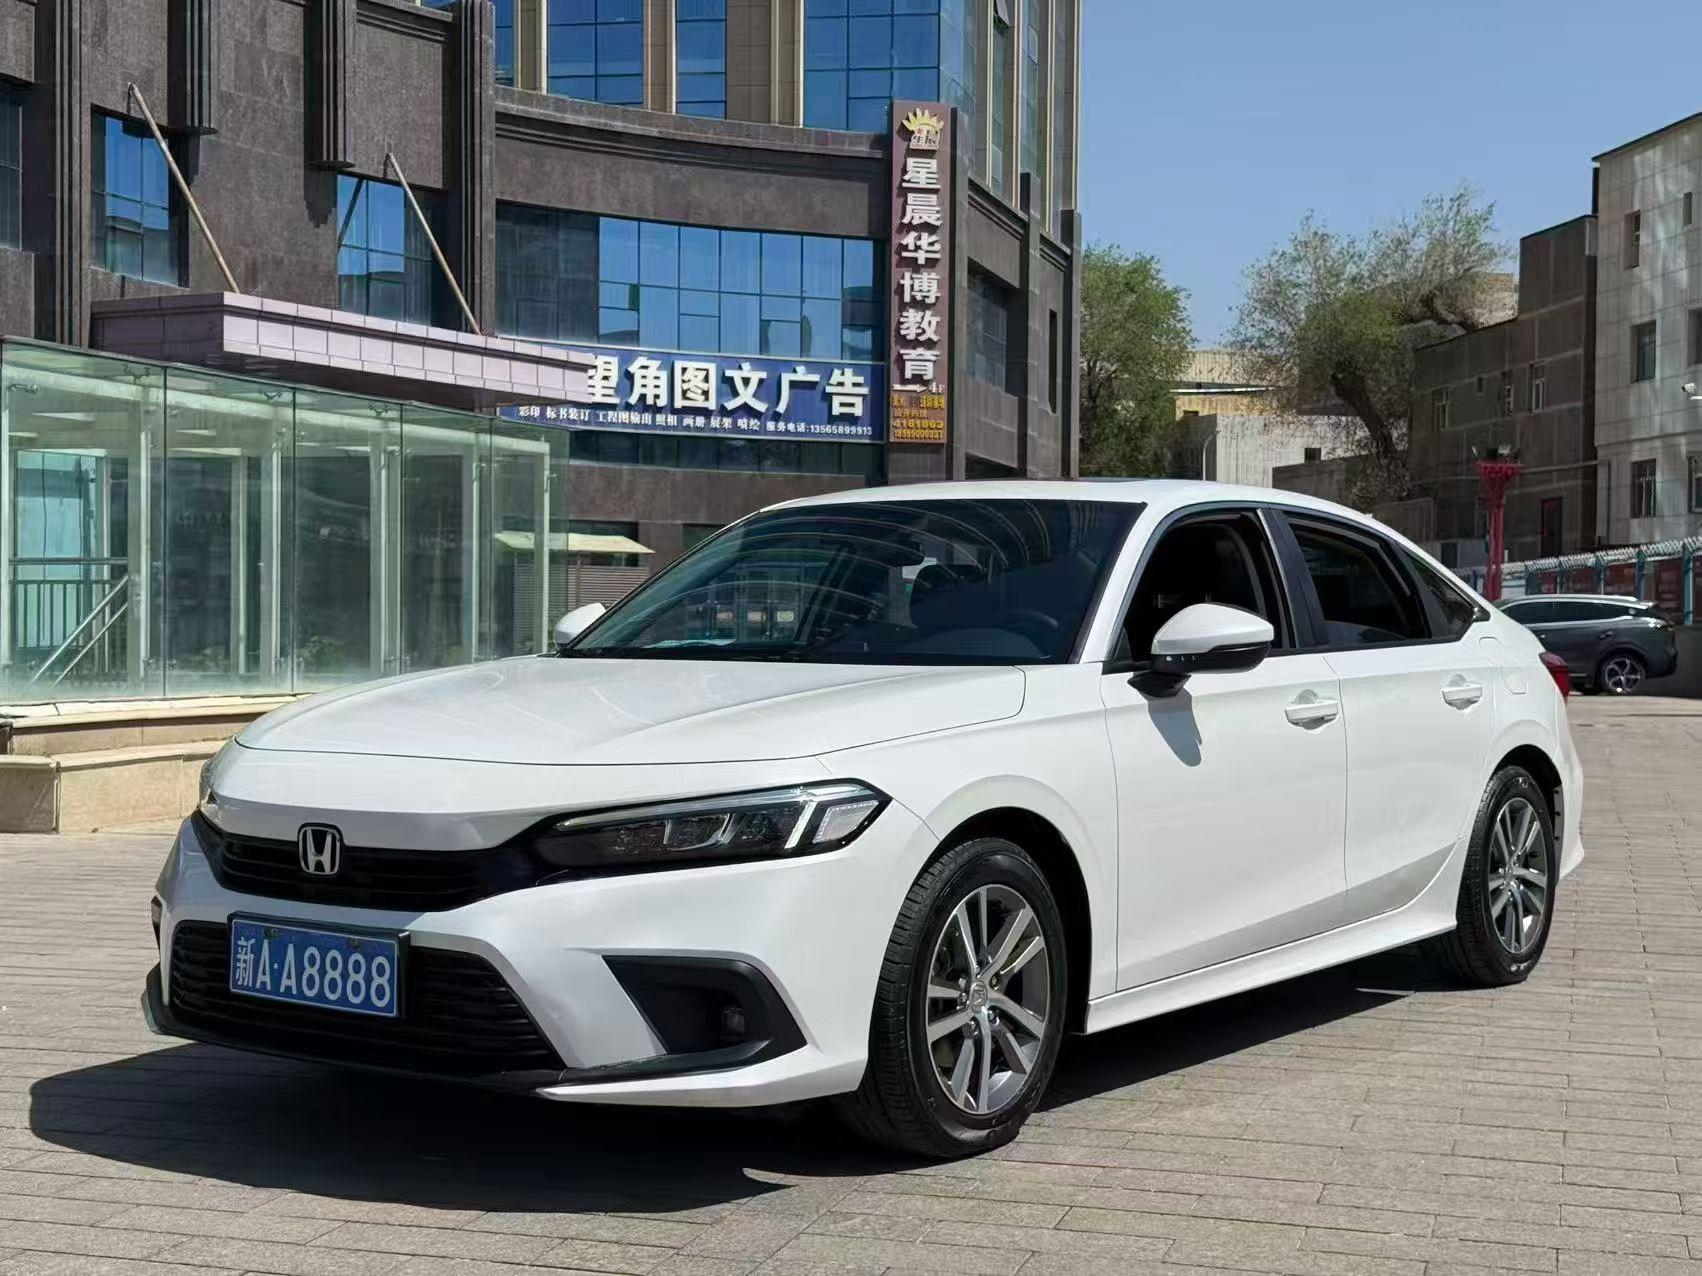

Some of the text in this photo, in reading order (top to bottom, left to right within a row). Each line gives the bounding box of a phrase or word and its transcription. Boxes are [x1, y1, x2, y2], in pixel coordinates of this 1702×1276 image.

[899, 157, 944, 381] 星晨华博教育
[518, 405, 540, 418] 彩印
[546, 406, 590, 421] 标书装订
[596, 410, 651, 425] 工程图输出
[655, 413, 678, 427] 照相
[737, 418, 760, 431] 喷绘
[236, 936, 391, 1008] 新A·A8888
